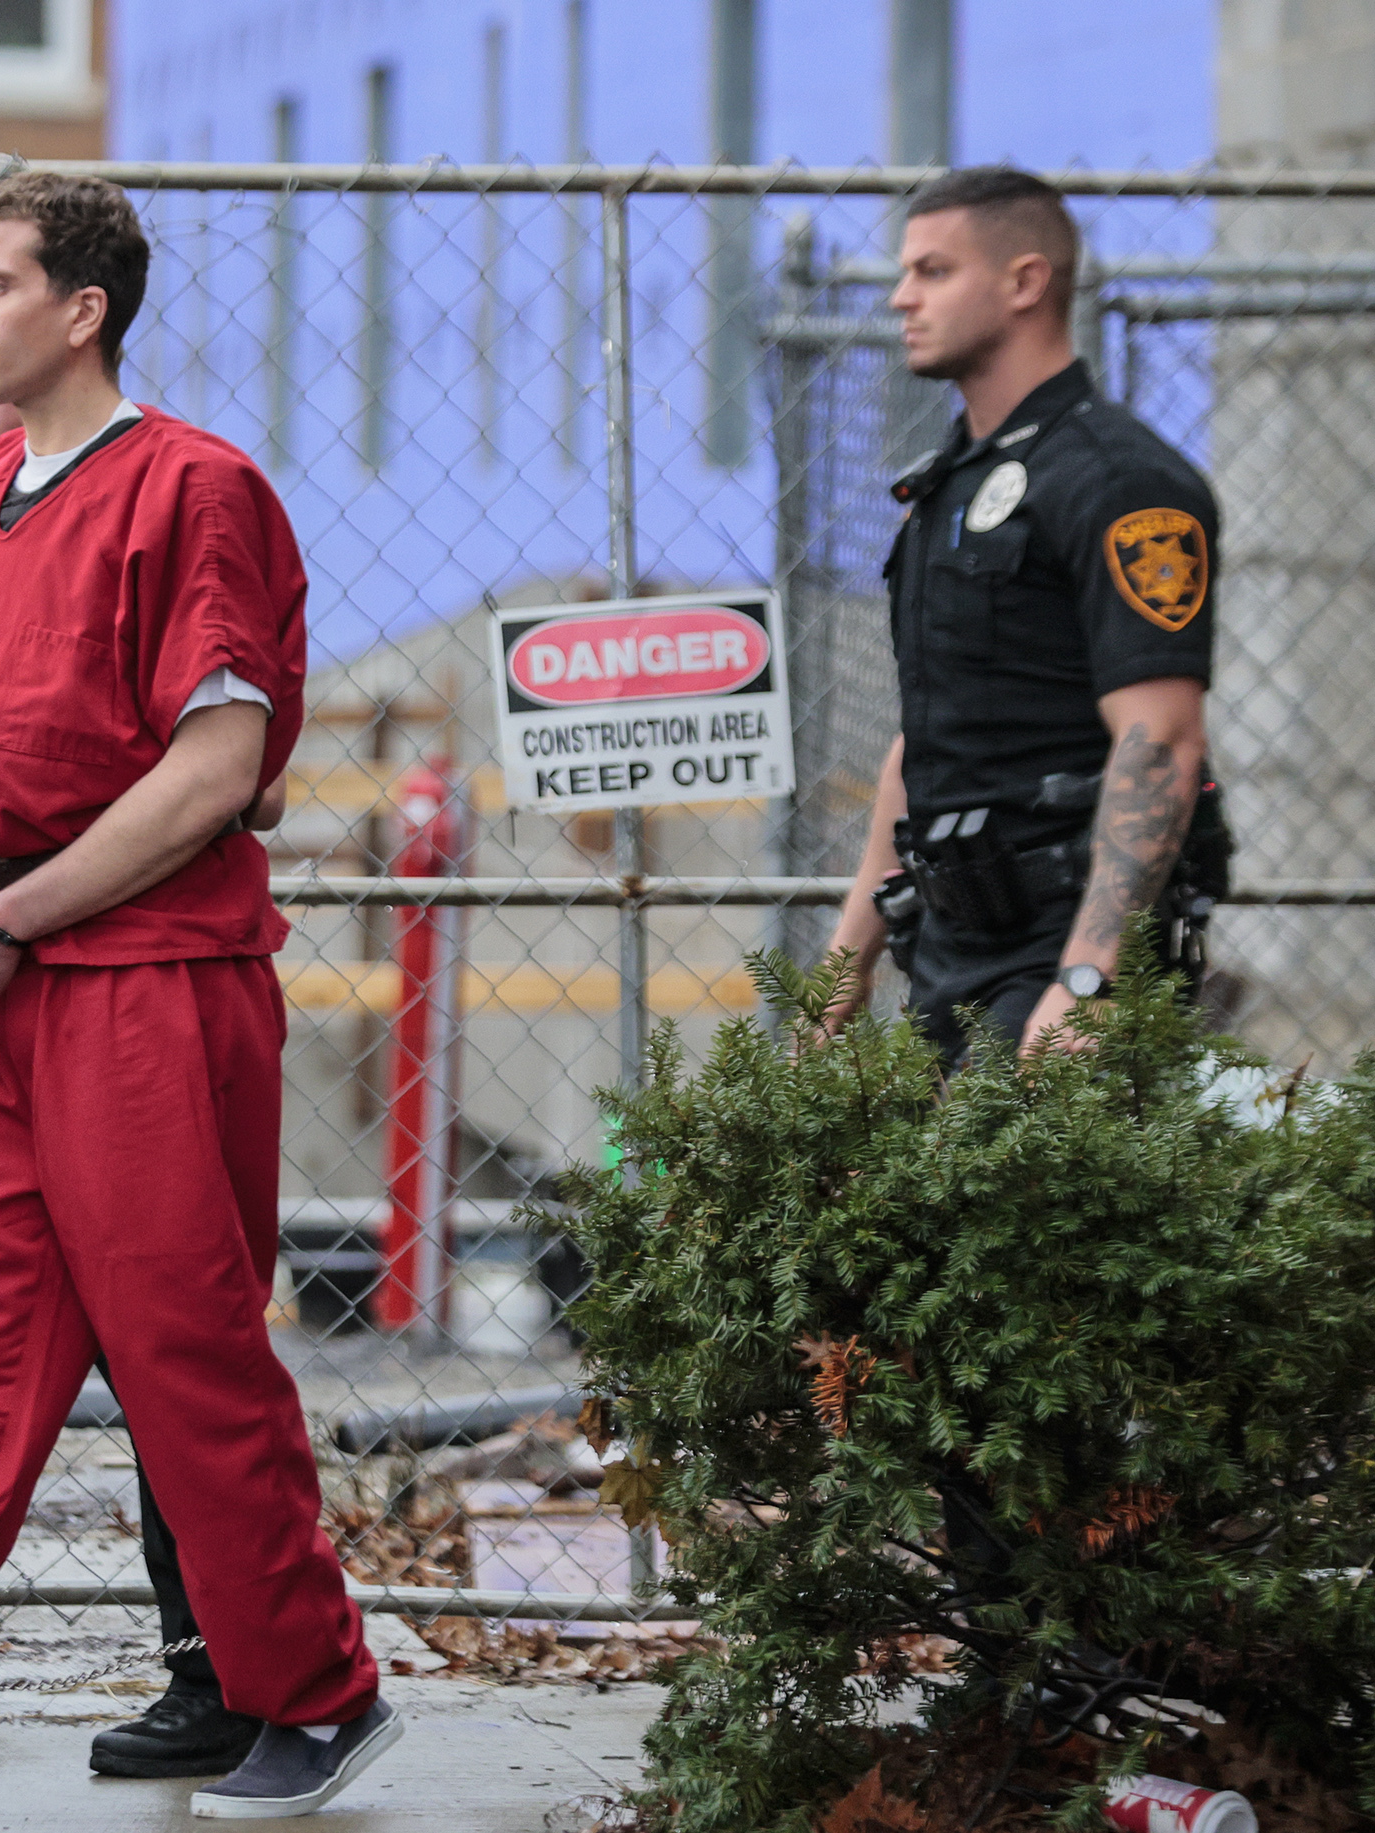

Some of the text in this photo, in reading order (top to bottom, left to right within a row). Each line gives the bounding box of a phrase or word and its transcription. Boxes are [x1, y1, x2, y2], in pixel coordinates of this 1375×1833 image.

[530, 630, 749, 685] DANGER
[523, 710, 770, 757] CONSTRUCTION AREA
[535, 764, 652, 798] KEEP
[672, 752, 762, 786] OUT
